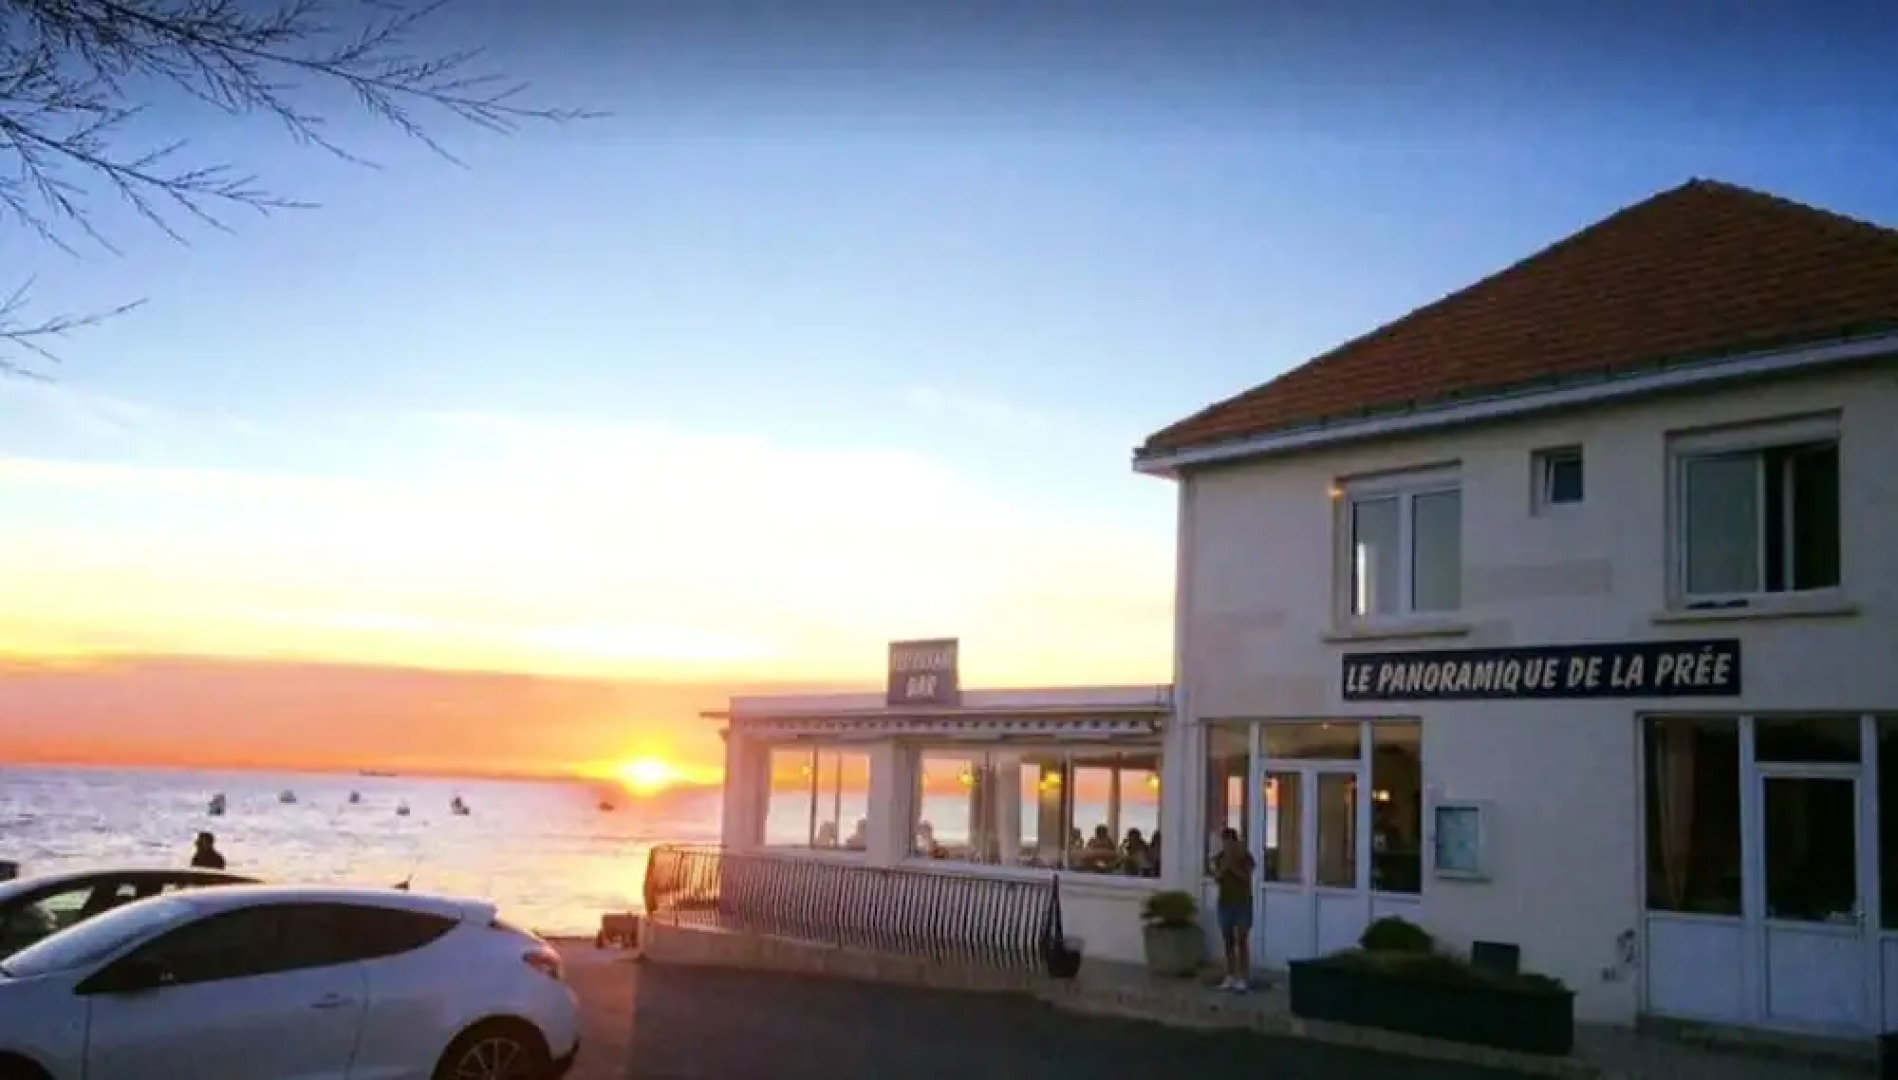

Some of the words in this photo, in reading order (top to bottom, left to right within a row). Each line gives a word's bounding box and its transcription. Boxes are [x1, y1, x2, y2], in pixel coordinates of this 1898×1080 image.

[907, 674, 938, 698] BAR
[1346, 664, 1372, 690] LE
[1377, 658, 1559, 692] PANORAMIQUE
[1568, 656, 1603, 688] DE
[1610, 654, 1645, 687] LA
[1655, 645, 1732, 686] PRÉE
